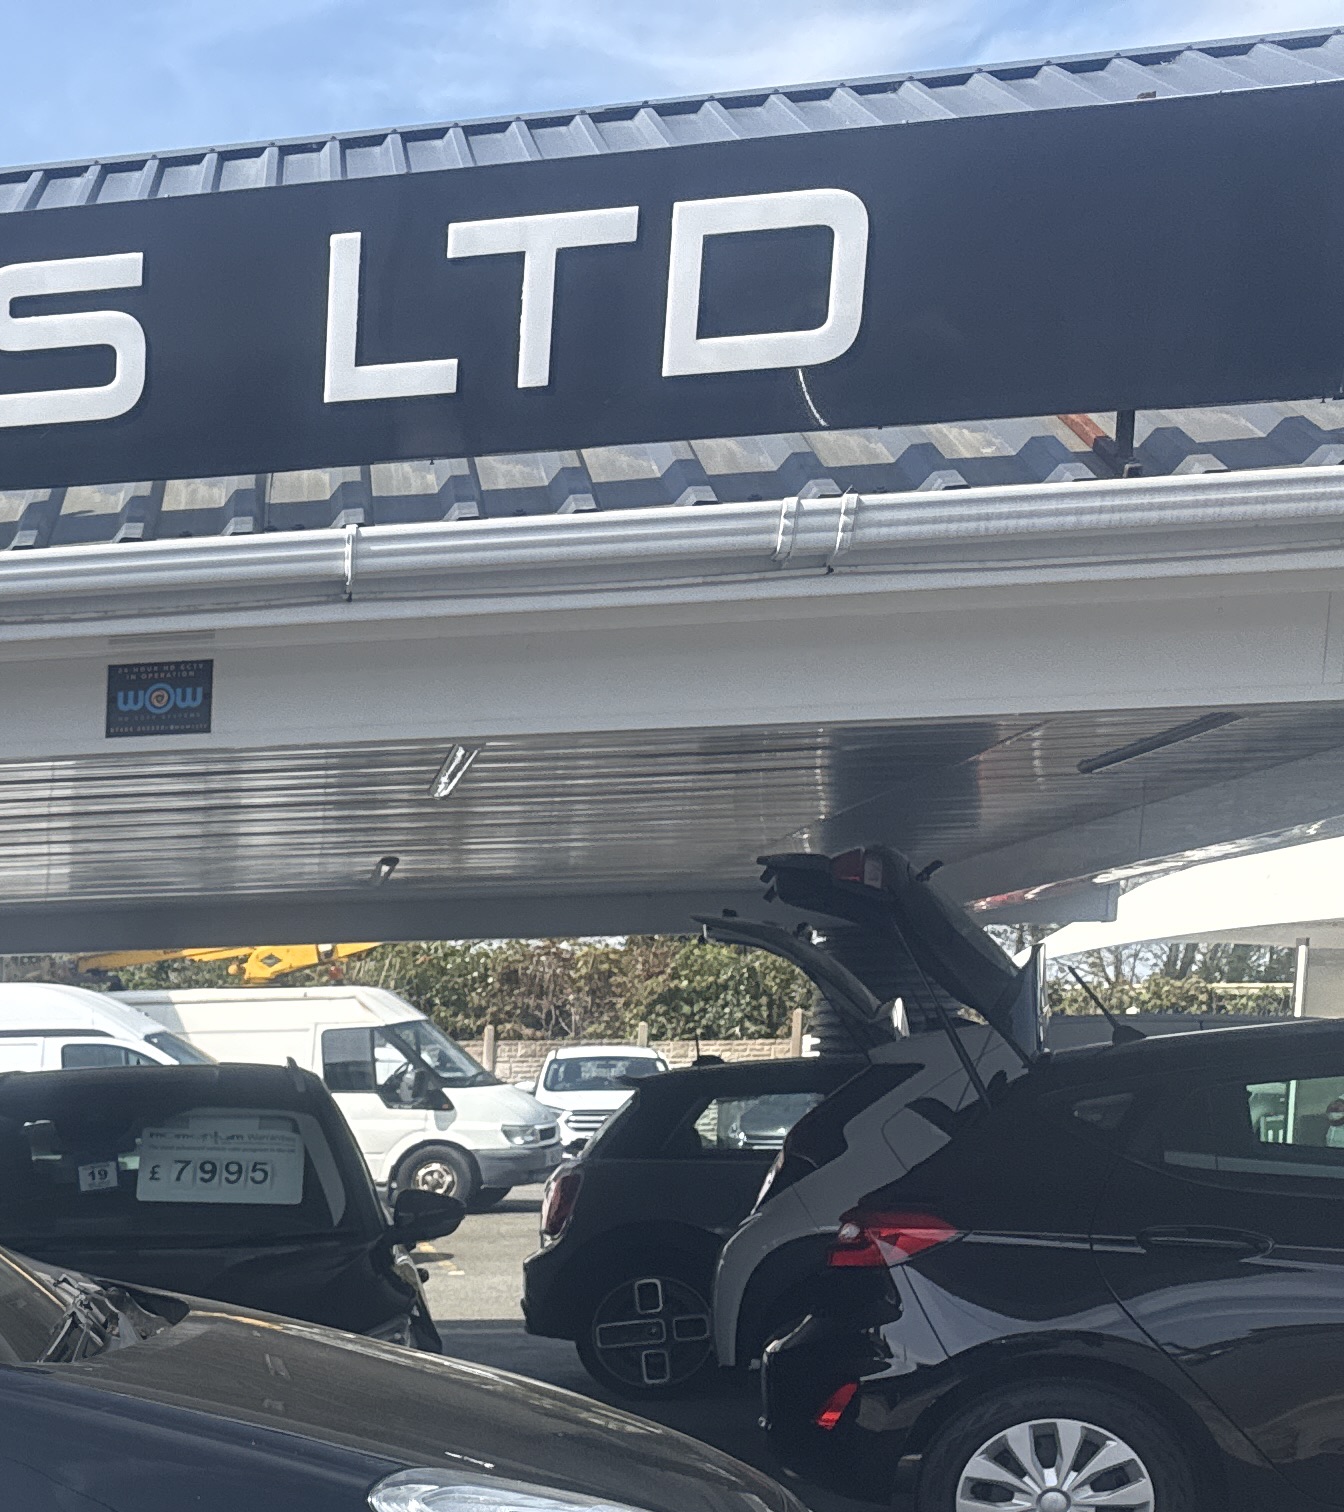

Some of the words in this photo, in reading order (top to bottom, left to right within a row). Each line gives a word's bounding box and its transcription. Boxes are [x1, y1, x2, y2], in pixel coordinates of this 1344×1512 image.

[323, 188, 869, 404] LTD
[133, 665, 158, 673] HOUR
[140, 671, 195, 680] OPERATION
[87, 1168, 108, 1181] 19
